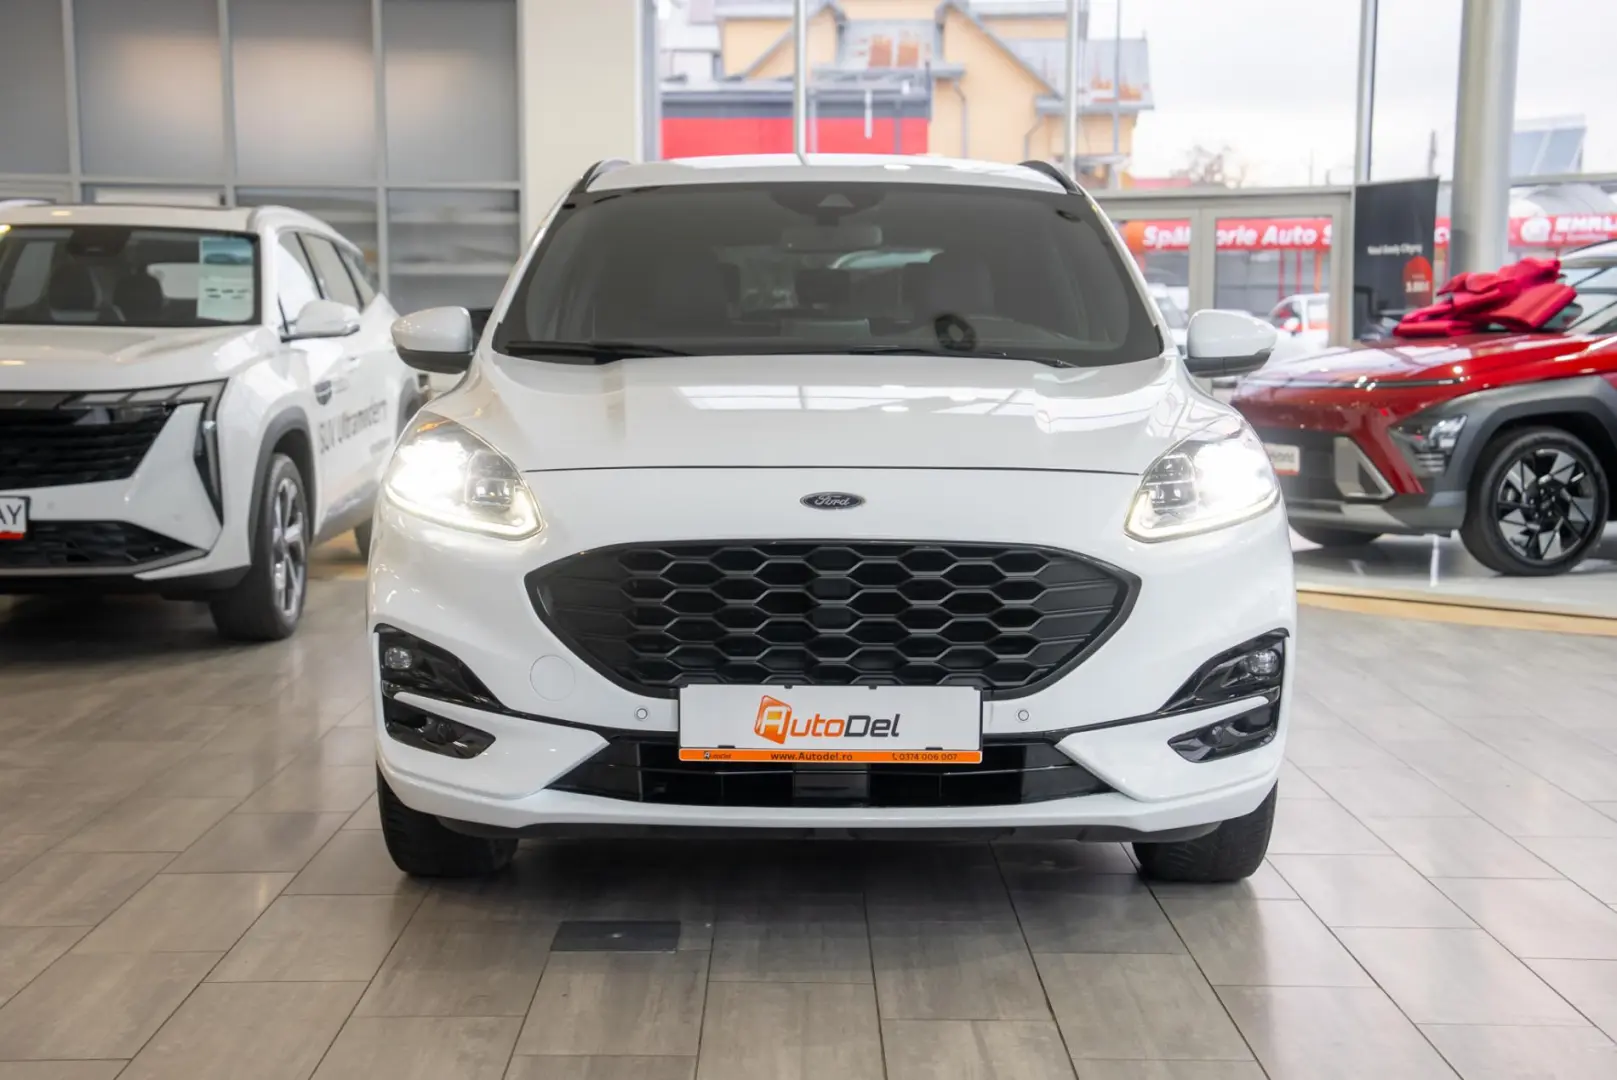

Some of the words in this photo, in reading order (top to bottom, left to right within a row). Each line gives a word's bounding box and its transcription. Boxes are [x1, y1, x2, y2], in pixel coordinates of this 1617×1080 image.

[1261, 224, 1319, 246] Auto
[814, 495, 850, 506] Ford
[754, 695, 900, 744] AutoDel
[770, 752, 853, 760] www.Autodel.ro
